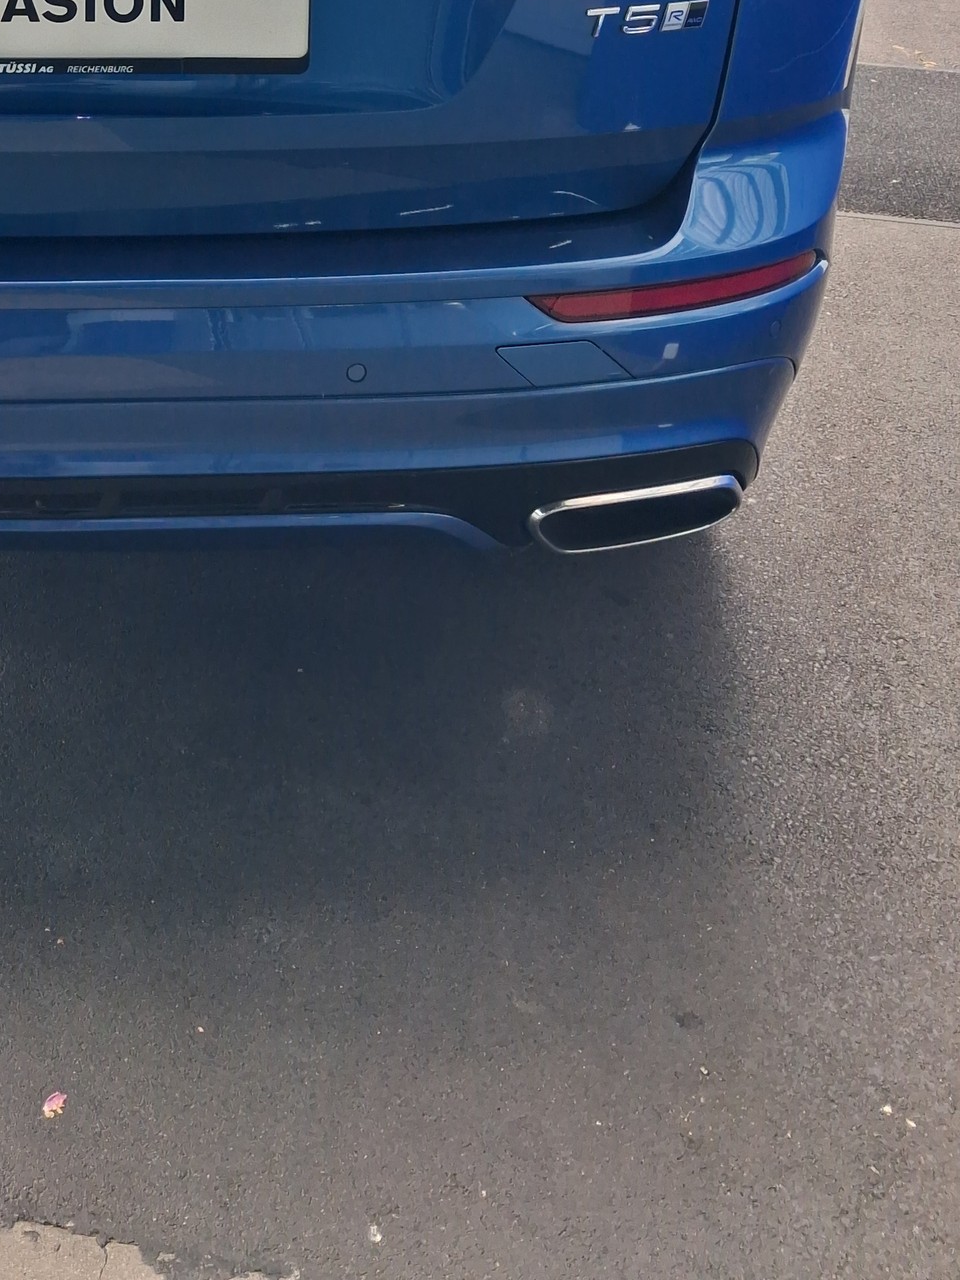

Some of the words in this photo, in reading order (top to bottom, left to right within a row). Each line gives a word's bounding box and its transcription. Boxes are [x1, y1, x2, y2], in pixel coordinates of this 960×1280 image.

[586, 3, 661, 39] T5
[38, 65, 54, 74] AG
[66, 65, 134, 74] REICHENBURG
